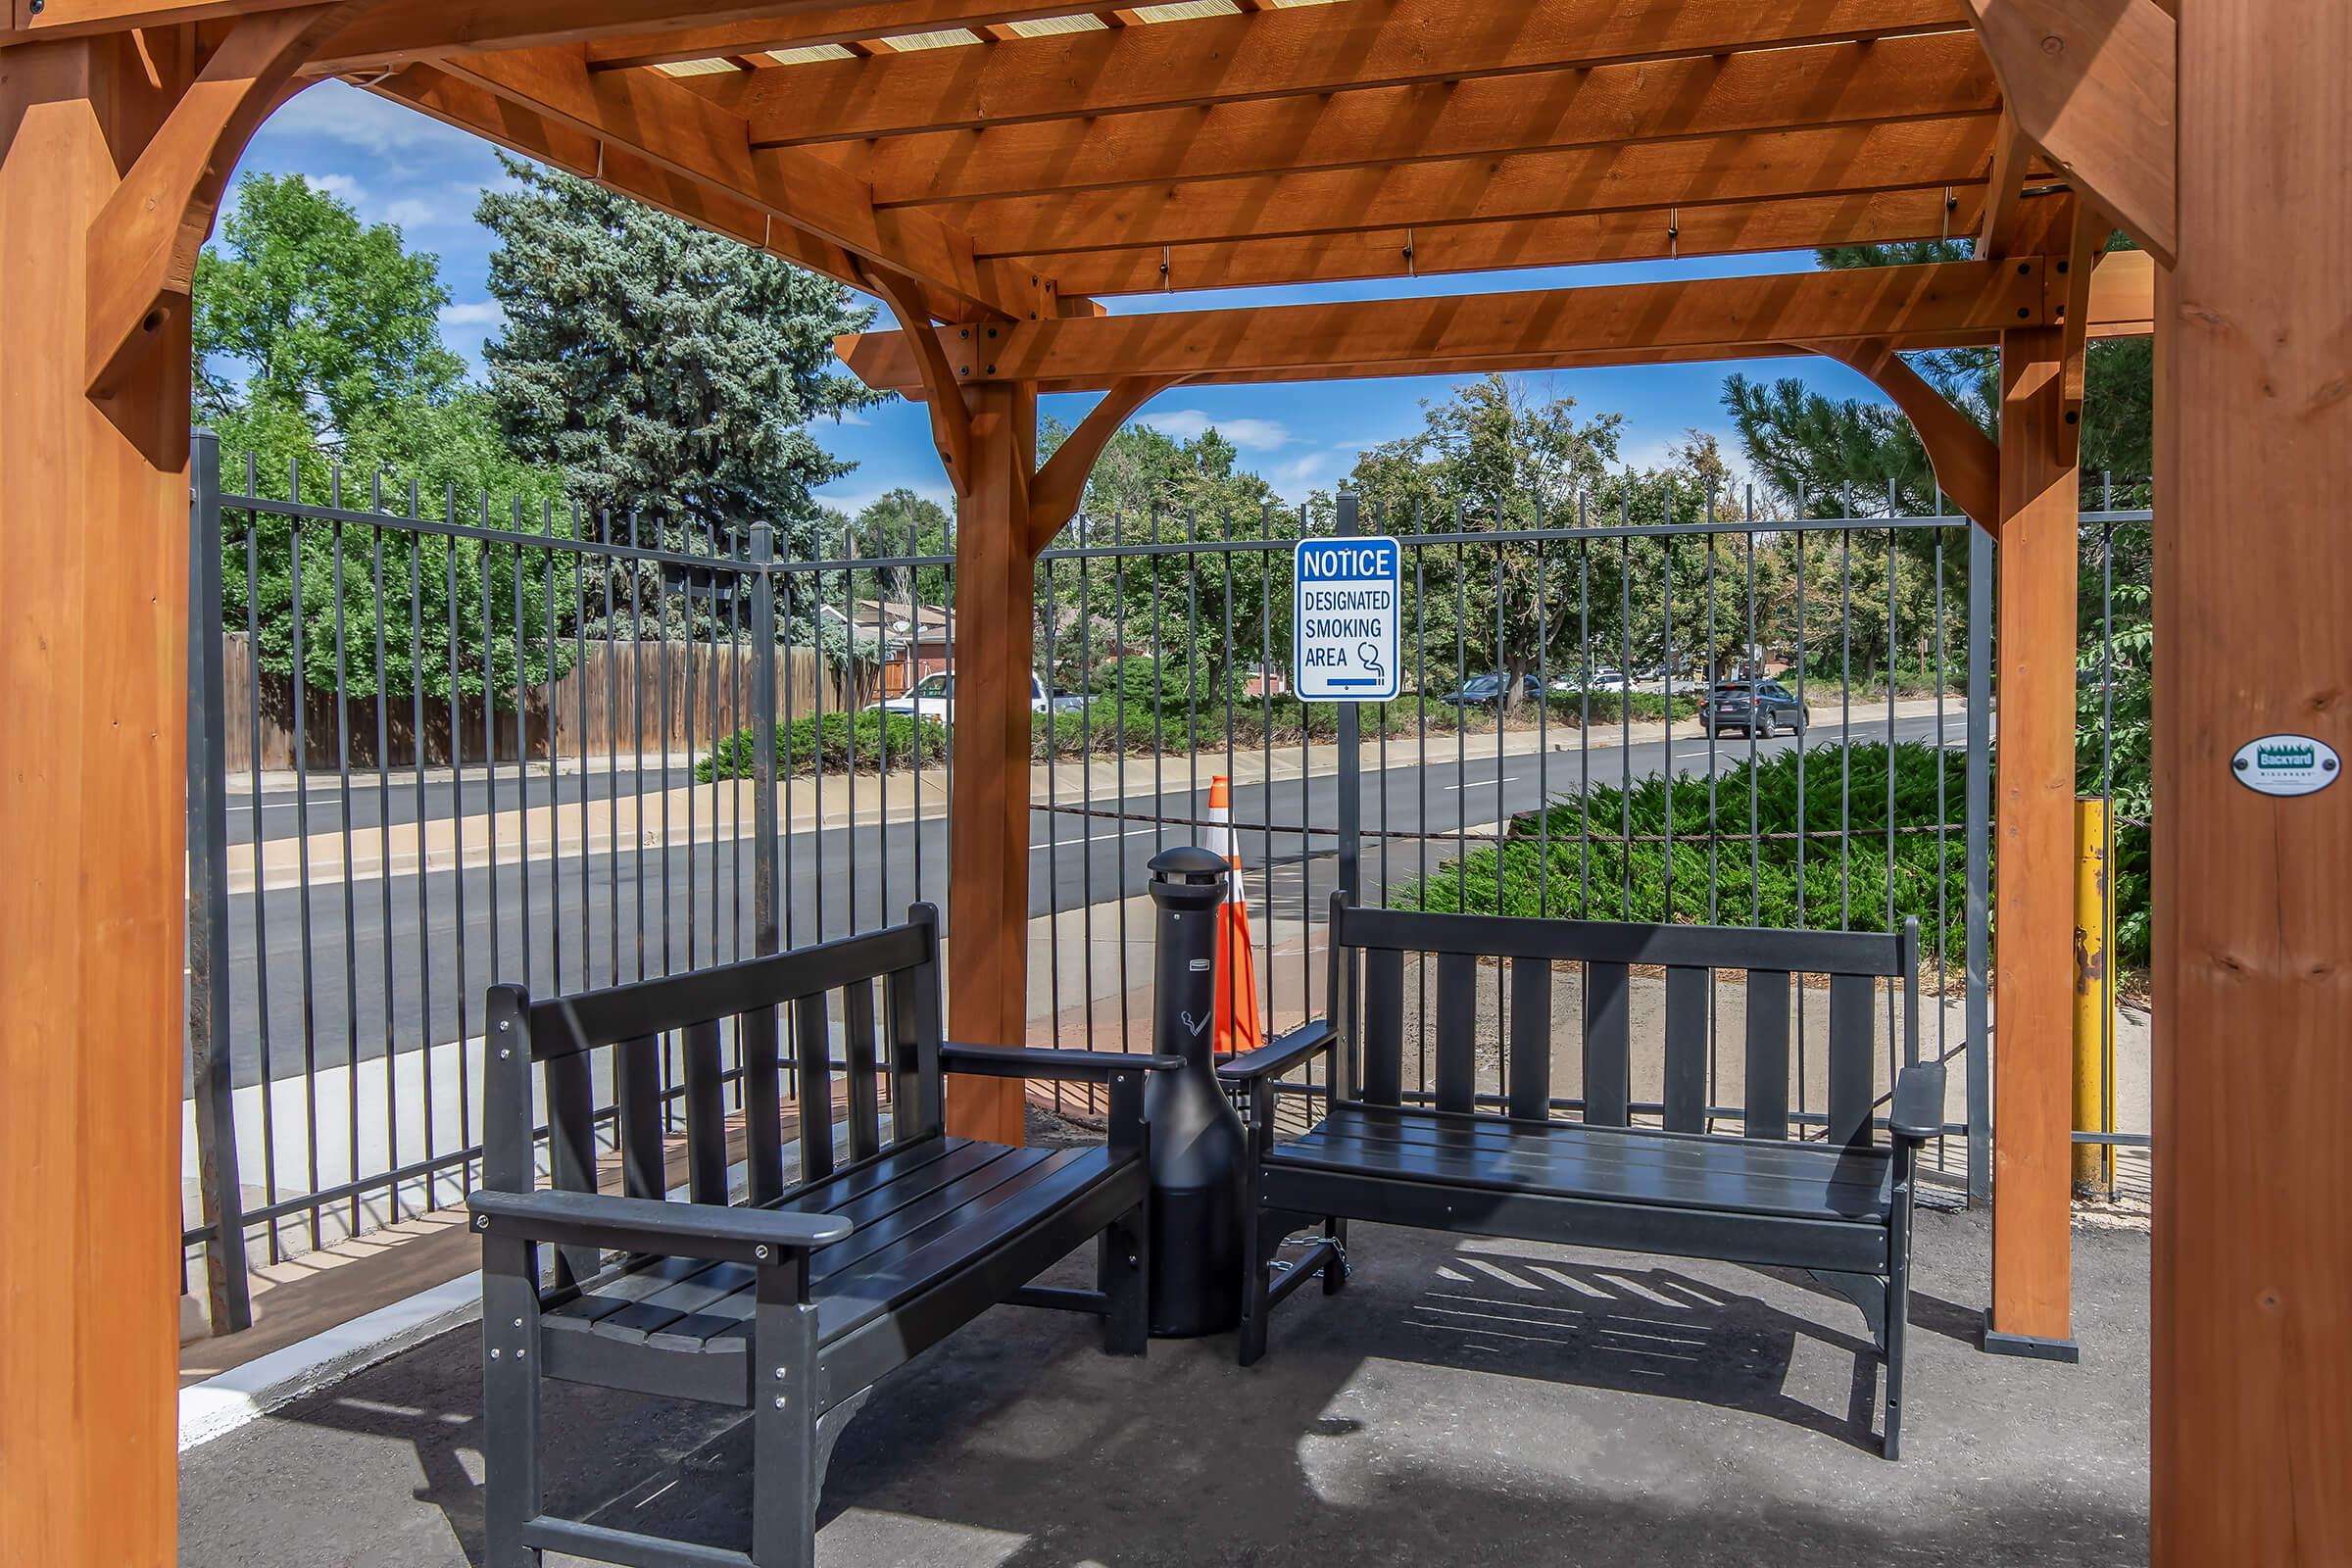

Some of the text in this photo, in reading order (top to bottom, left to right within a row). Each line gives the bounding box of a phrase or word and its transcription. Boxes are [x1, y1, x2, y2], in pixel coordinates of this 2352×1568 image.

[1303, 549, 1391, 577] NOTICE
[1304, 590, 1391, 611] DESIGNATED
[1305, 617, 1382, 638] SMOKING
[1304, 647, 1348, 667] AREA
